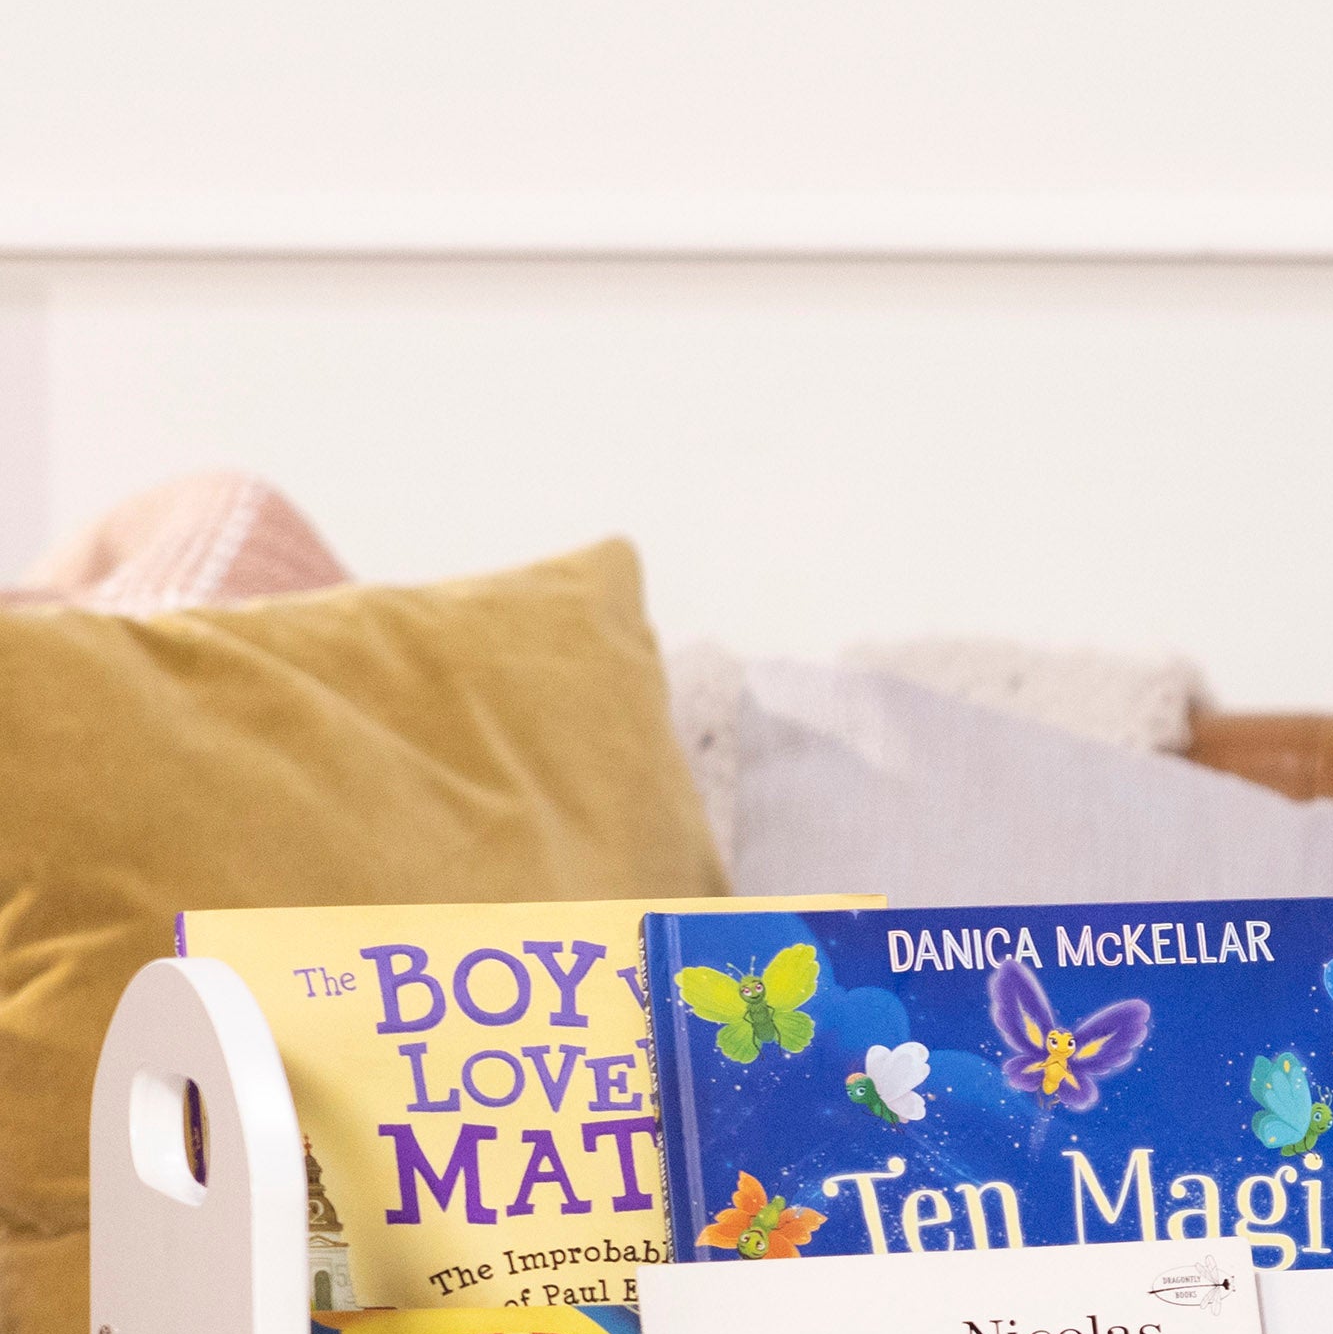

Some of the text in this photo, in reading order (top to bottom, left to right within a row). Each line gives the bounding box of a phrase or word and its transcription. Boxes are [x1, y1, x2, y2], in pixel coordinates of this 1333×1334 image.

[887, 922, 1043, 974] DANICA
[293, 967, 357, 1000] The
[359, 939, 608, 1035] BOY
[398, 1038, 658, 1113] LOVE
[822, 1157, 1019, 1257] Ten
[429, 1262, 494, 1297] The
[543, 1279, 611, 1306] Paul
